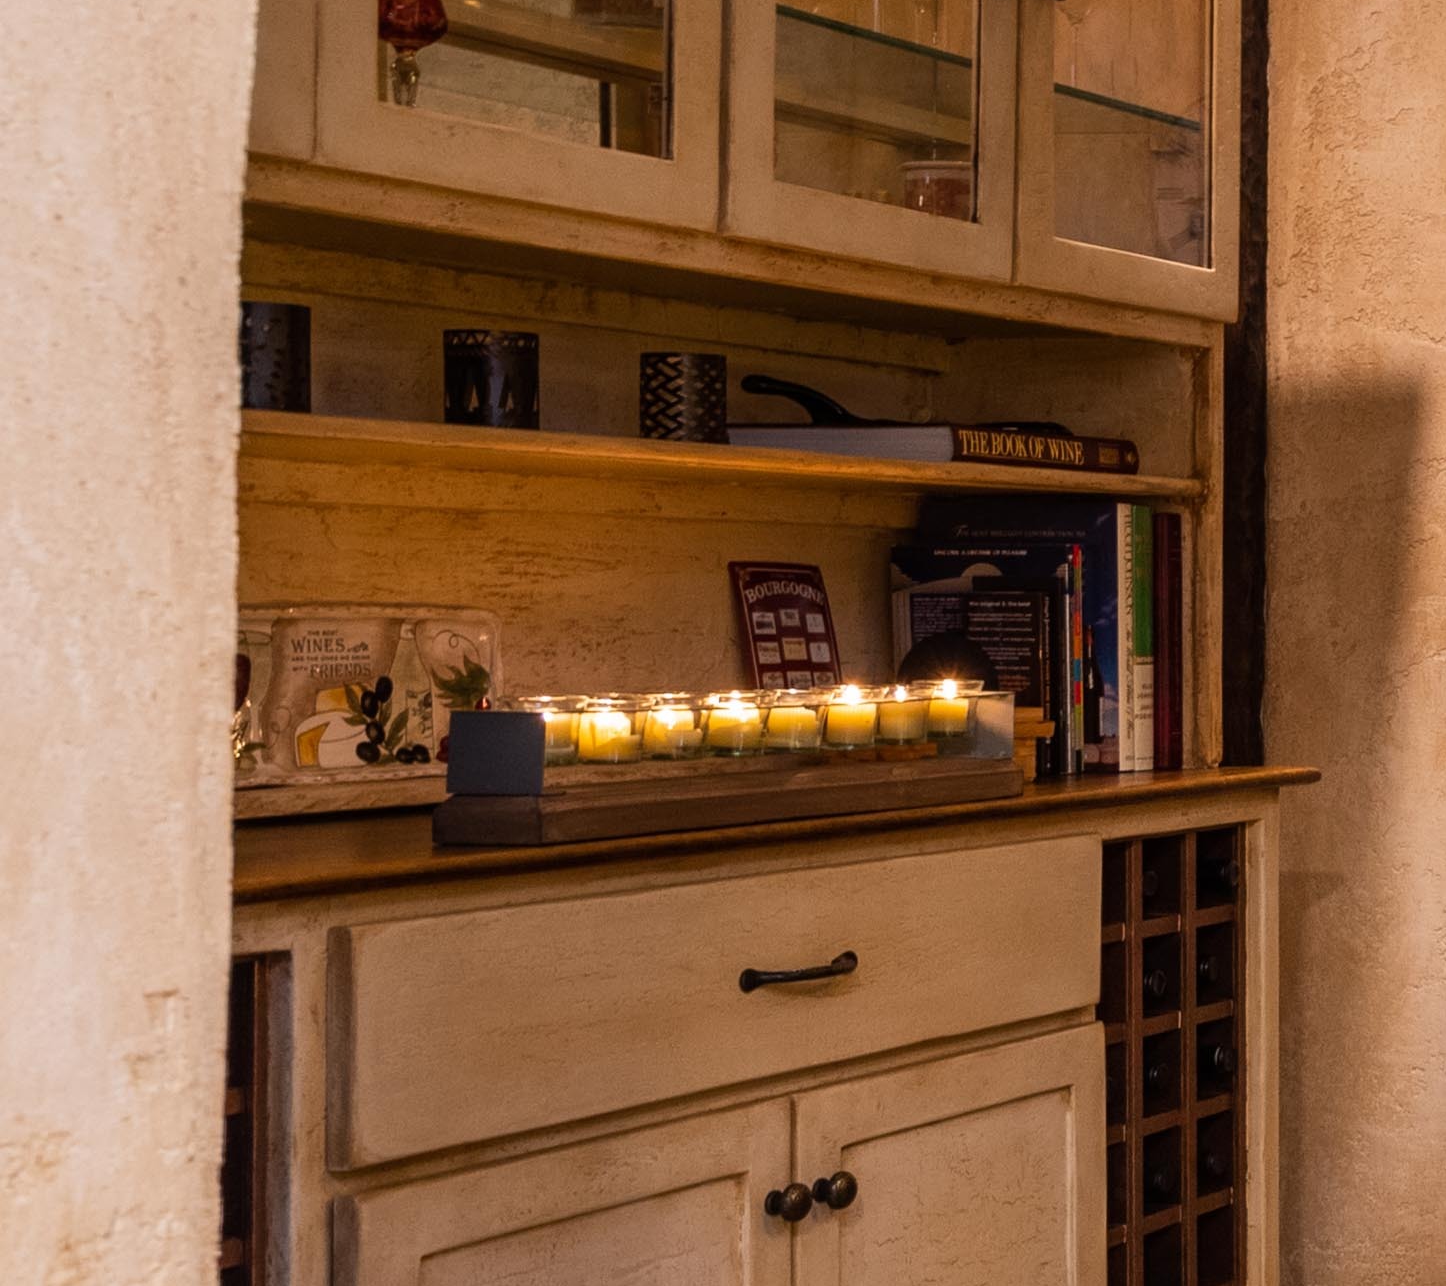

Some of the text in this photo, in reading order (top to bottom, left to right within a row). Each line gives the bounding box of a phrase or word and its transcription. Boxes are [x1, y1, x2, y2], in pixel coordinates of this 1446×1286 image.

[959, 430, 990, 456] THE
[991, 431, 1028, 458] BOOK
[1029, 434, 1046, 459] OF
[1047, 438, 1085, 466] WINE
[291, 636, 345, 653] WINES
[309, 662, 371, 679] FRIENDS
